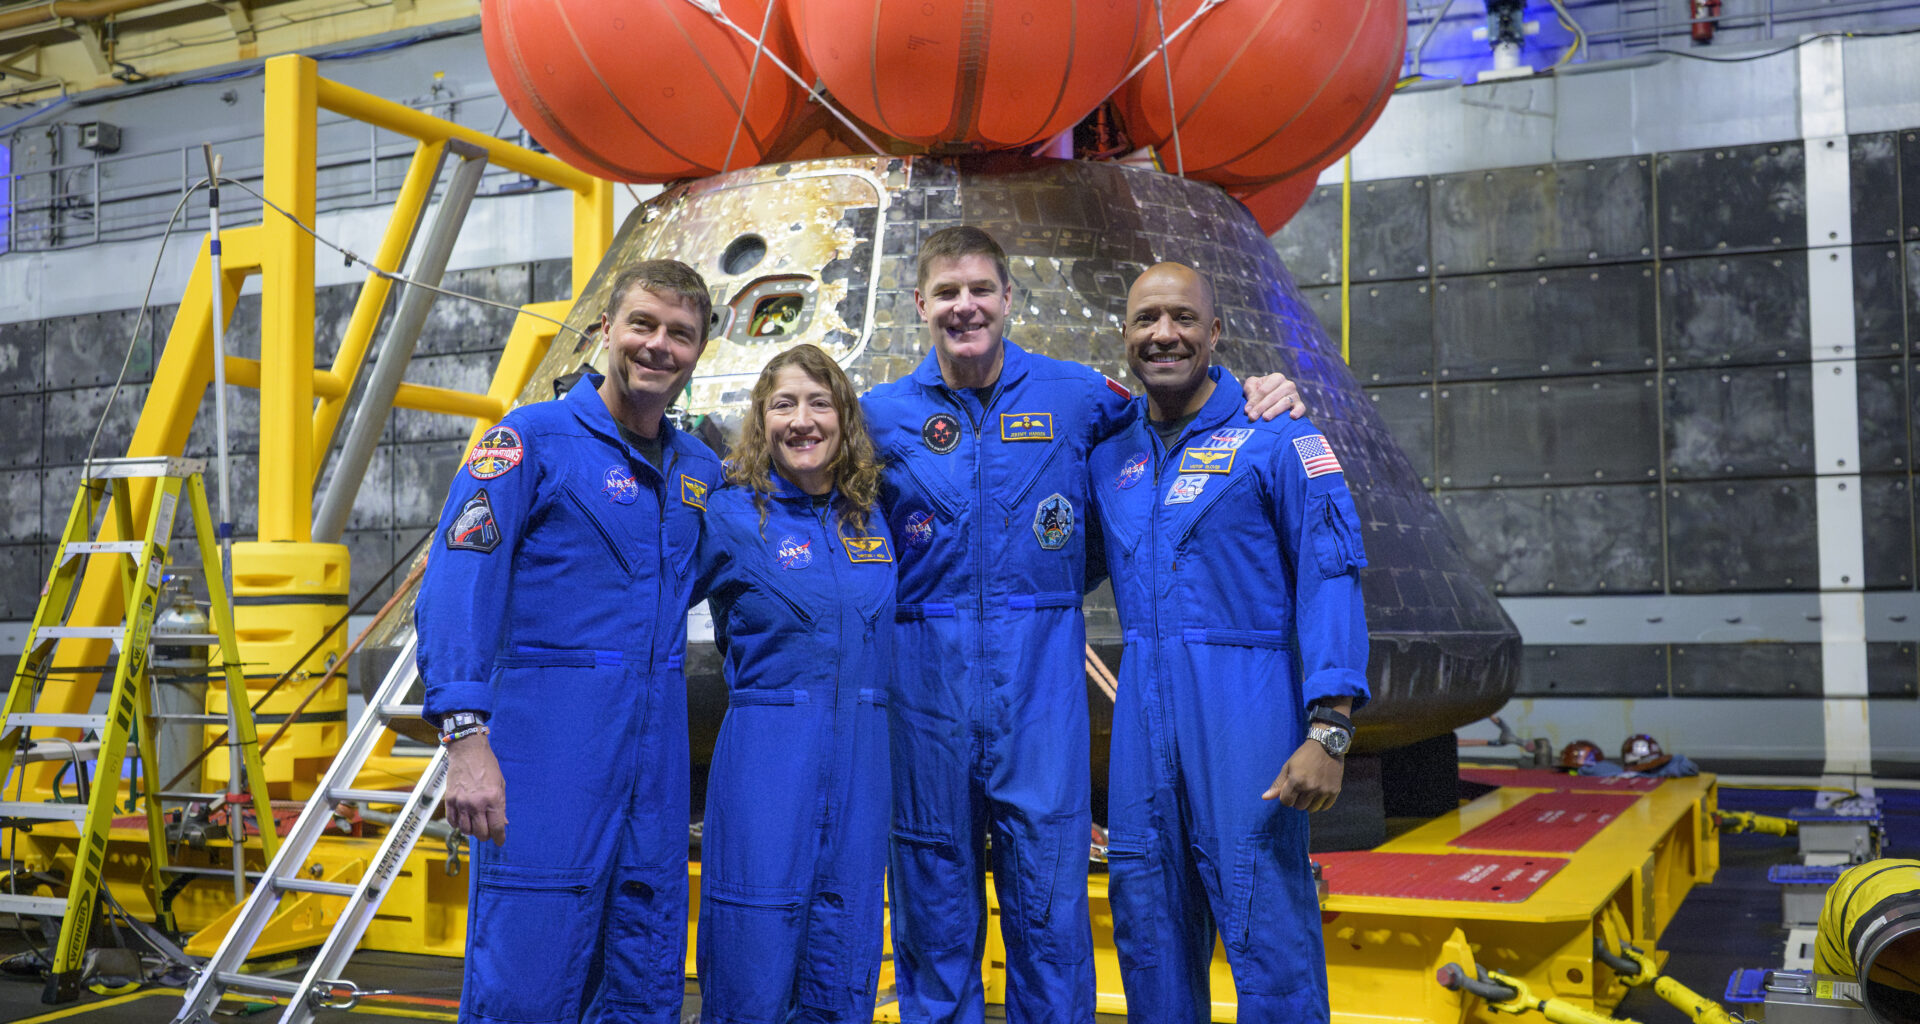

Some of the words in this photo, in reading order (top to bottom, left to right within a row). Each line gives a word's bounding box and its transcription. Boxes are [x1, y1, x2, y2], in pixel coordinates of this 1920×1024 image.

[487, 448, 521, 462] OPERATIONS
[606, 479, 638, 490] NASA
[778, 546, 810, 558] NASA
[70, 905, 87, 962] WERNER
